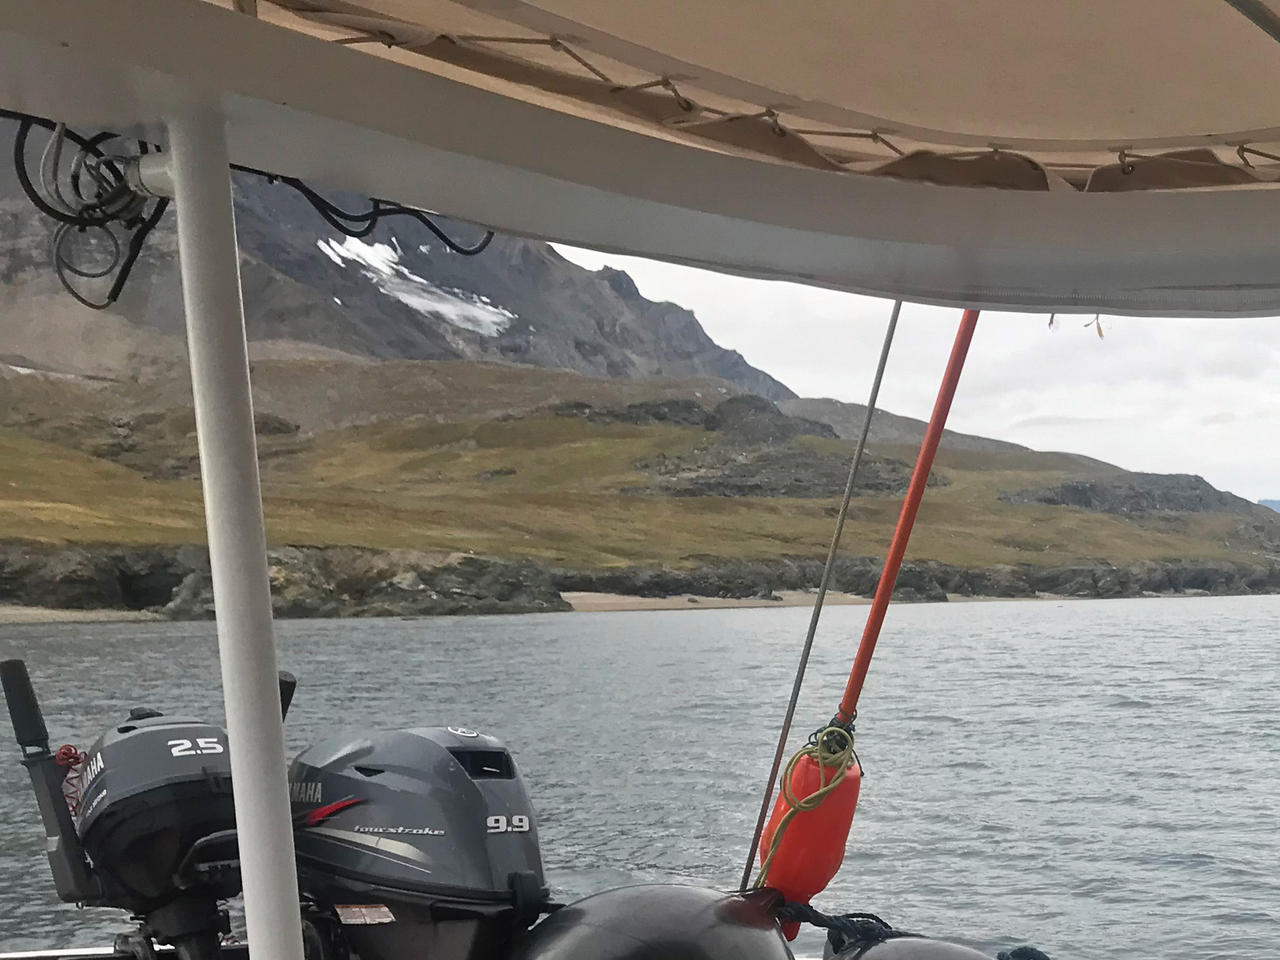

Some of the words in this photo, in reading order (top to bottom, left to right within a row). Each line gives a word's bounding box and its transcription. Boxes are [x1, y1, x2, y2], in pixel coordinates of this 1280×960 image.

[167, 737, 224, 757] 2.5
[289, 781, 322, 803] MAHA
[486, 814, 530, 833] 9.9
